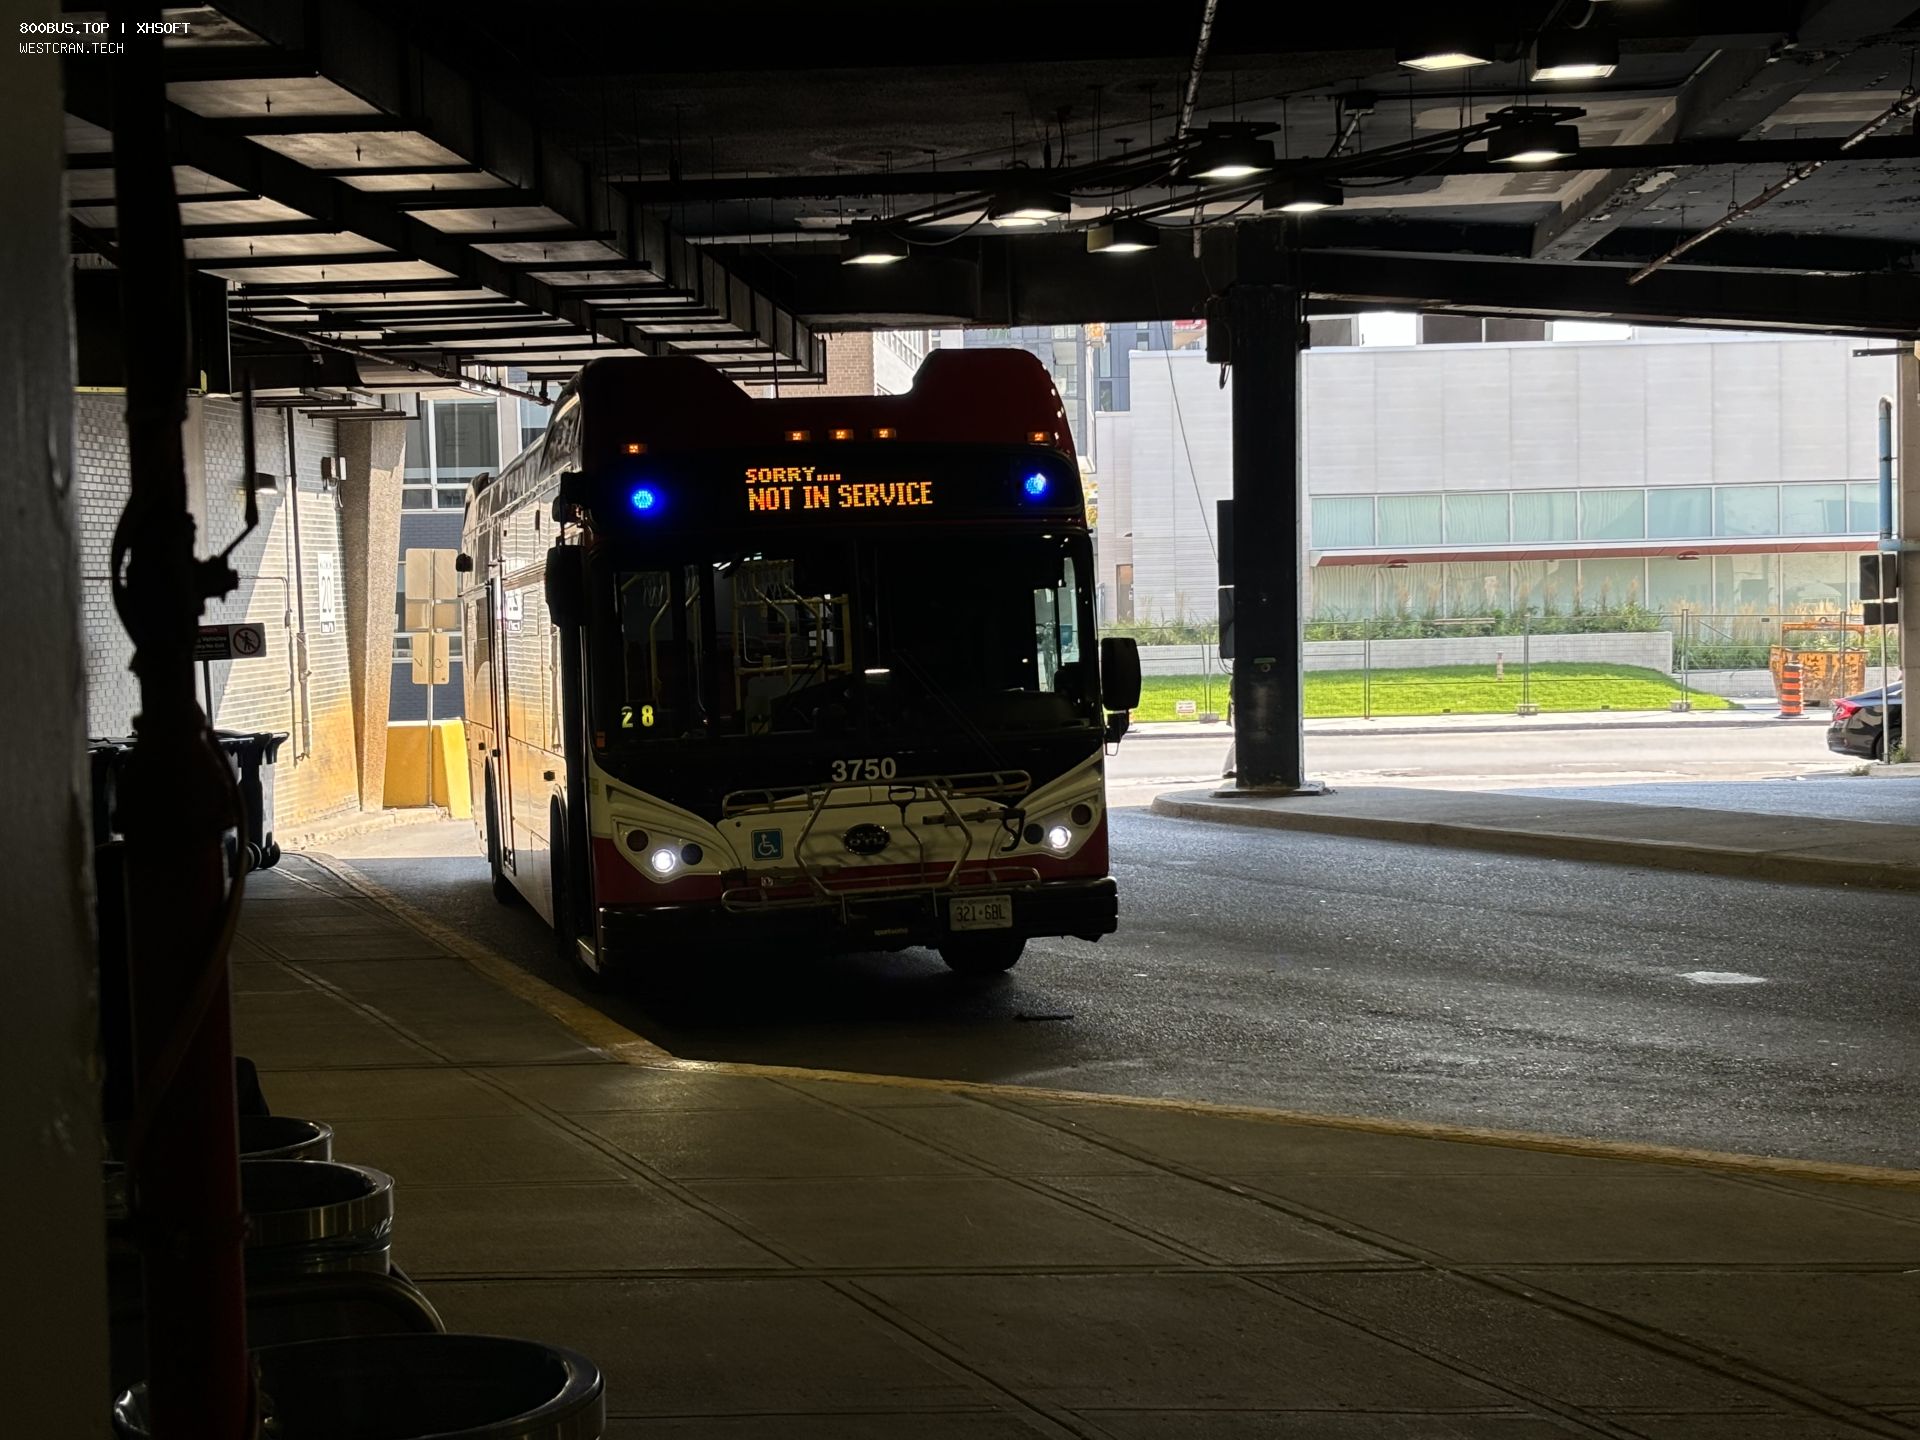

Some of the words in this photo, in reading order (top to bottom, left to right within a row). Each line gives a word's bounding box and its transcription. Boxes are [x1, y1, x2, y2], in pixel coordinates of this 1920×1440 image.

[747, 486, 794, 511] NOT
[802, 485, 831, 509] IN
[838, 481, 934, 508] SERVICE
[831, 756, 897, 783] 3750
